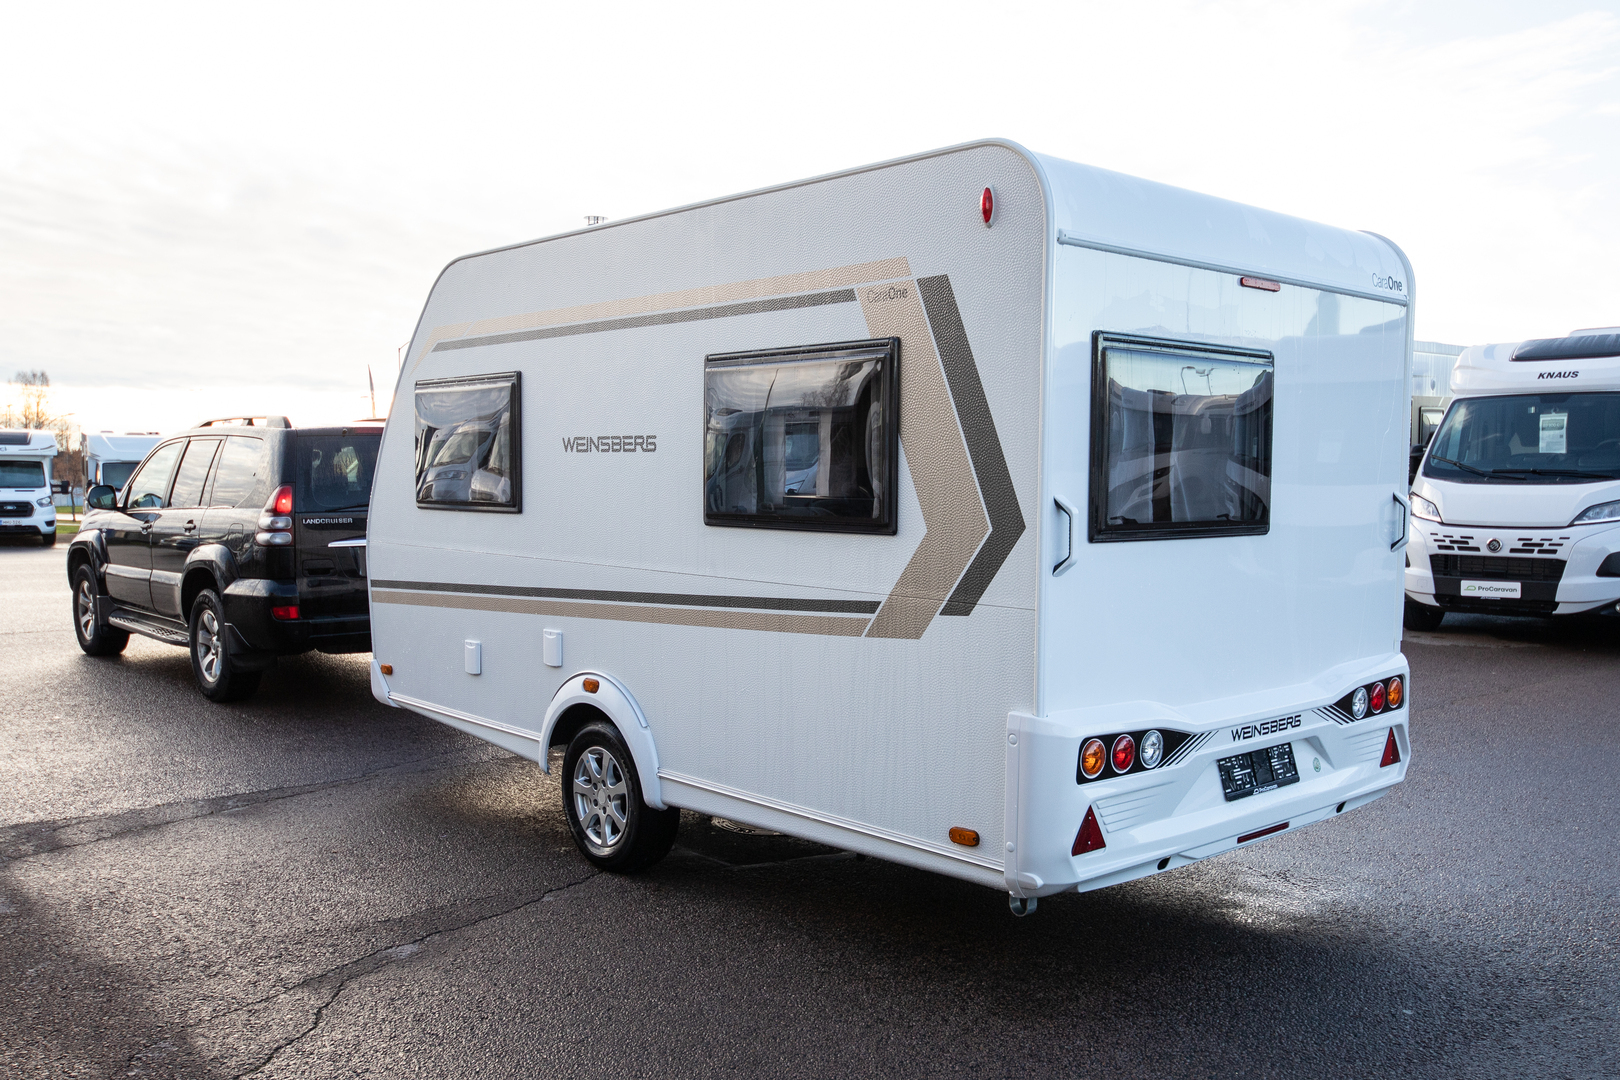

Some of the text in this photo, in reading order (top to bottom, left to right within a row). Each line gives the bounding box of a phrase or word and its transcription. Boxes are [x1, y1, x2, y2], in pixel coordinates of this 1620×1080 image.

[1372, 273, 1402, 291] CaraOne
[867, 286, 908, 303] CaraOne
[1538, 370, 1579, 380] KNAUS
[562, 435, 657, 453] WEINSBERG
[1477, 585, 1517, 593] ProCaravan
[1231, 714, 1301, 742] WEINSBERG
